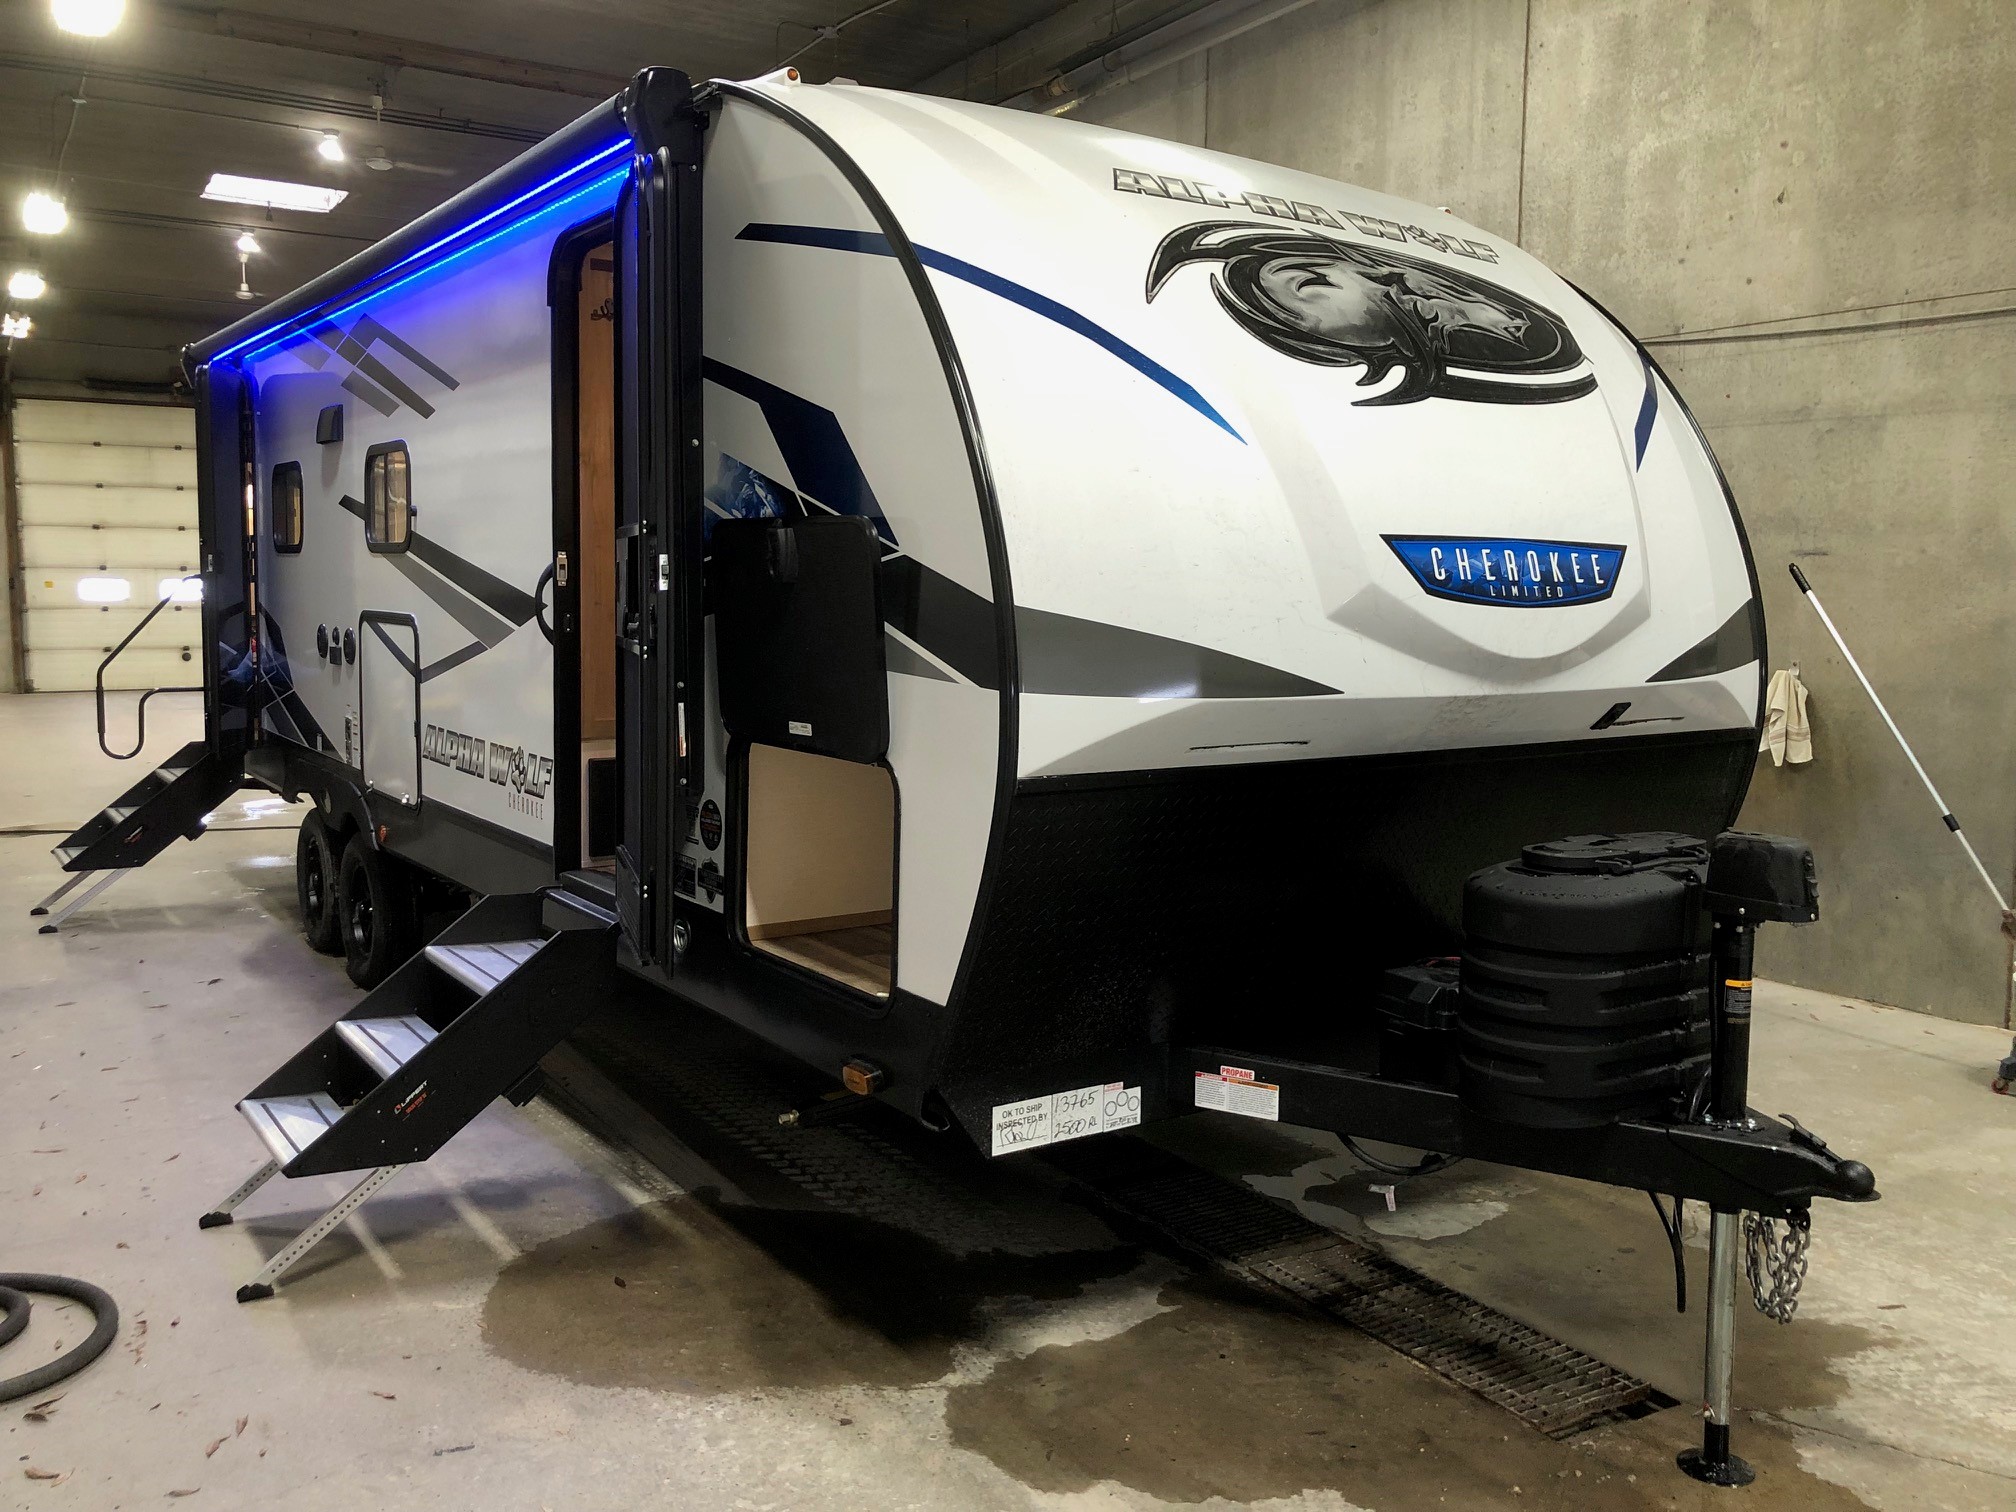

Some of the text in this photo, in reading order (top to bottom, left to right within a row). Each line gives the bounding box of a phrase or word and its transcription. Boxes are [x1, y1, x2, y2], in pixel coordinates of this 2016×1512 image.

[1112, 168, 1347, 230] ALPHA
[1430, 547, 1605, 585] CHEROKEE
[1490, 585, 1564, 598] LIMITED
[422, 724, 486, 779] ALPHA
[508, 792, 544, 820] CHEROKEE
[1221, 1067, 1253, 1080] PROPANE
[1002, 1103, 1043, 1119] OK TO SHIP
[1054, 1090, 1099, 1113] 13765
[996, 1113, 1048, 1131] INSPECTED BY
